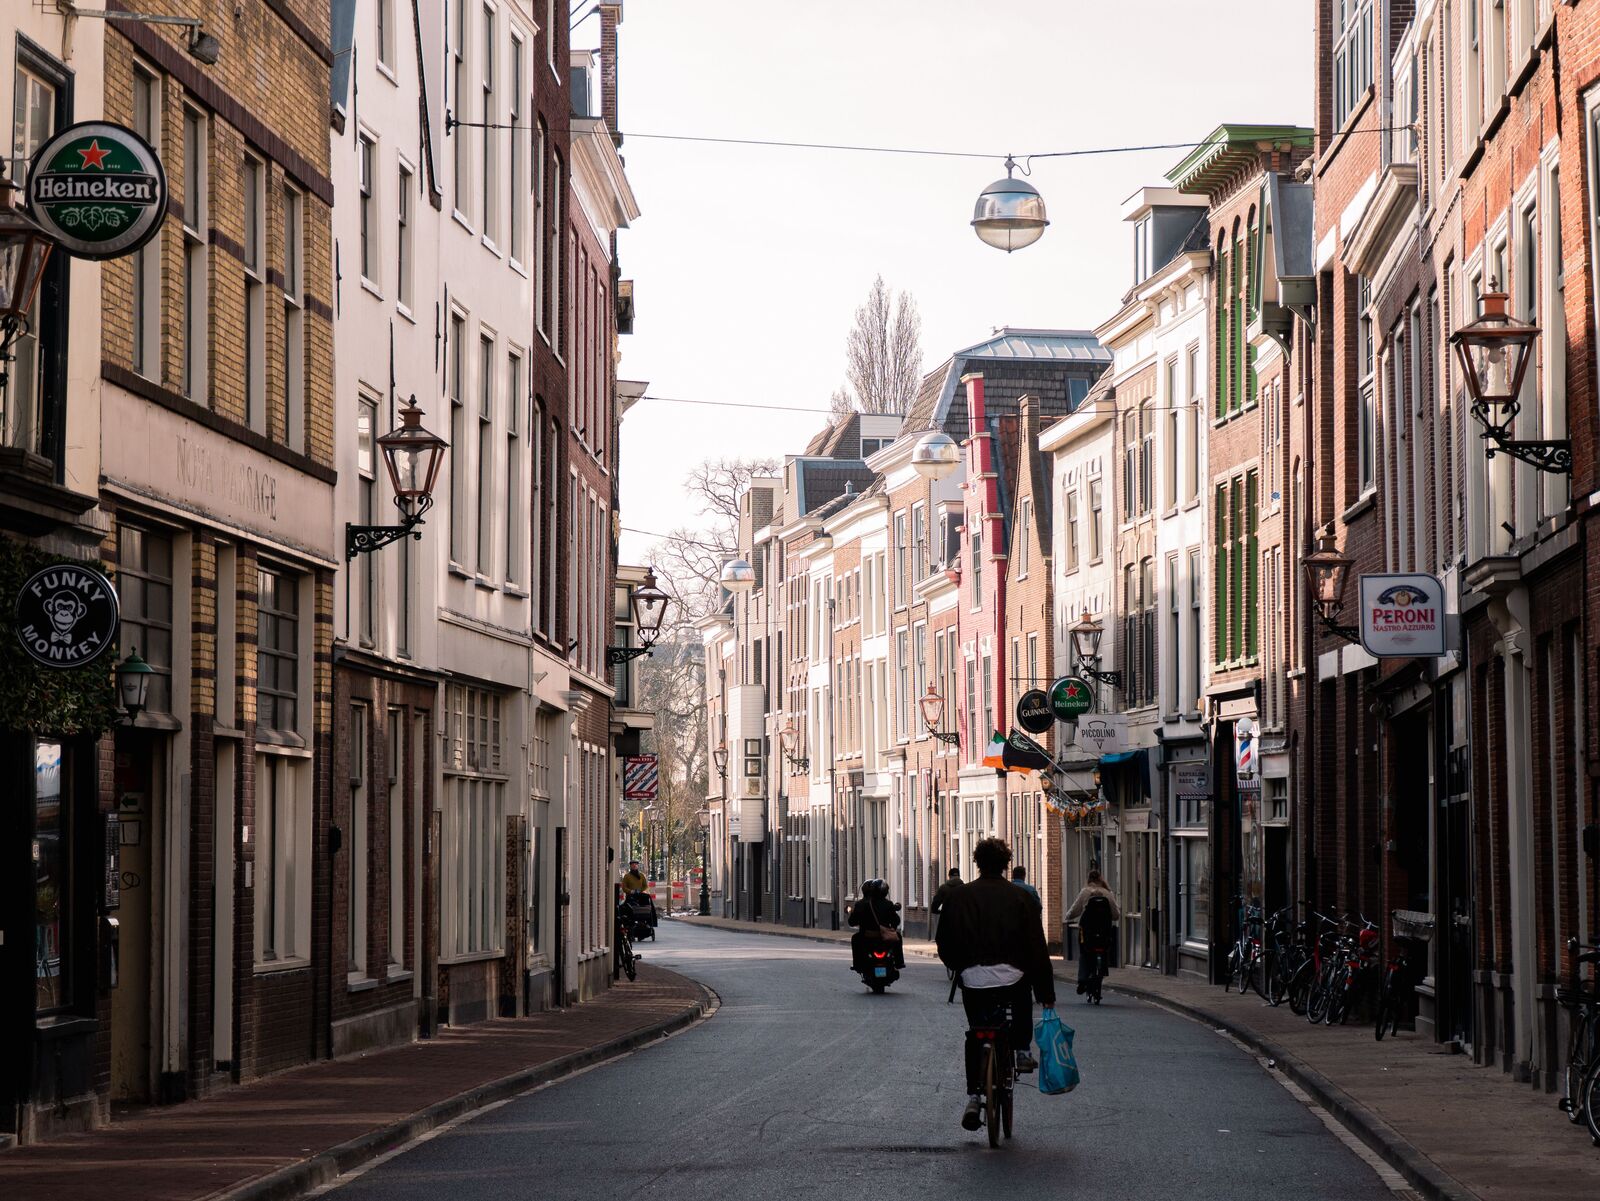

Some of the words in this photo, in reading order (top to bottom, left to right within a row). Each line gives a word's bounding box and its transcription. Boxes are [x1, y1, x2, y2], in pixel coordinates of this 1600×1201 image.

[39, 176, 151, 199] Heineken
[31, 572, 105, 601] FUNKY
[1372, 608, 1435, 624] PERONI
[22, 624, 100, 660] MONKEY
[1054, 699, 1089, 708] Heineken
[1022, 707, 1050, 718] GUINNES
[1081, 728, 1116, 738] PICCOLINO
